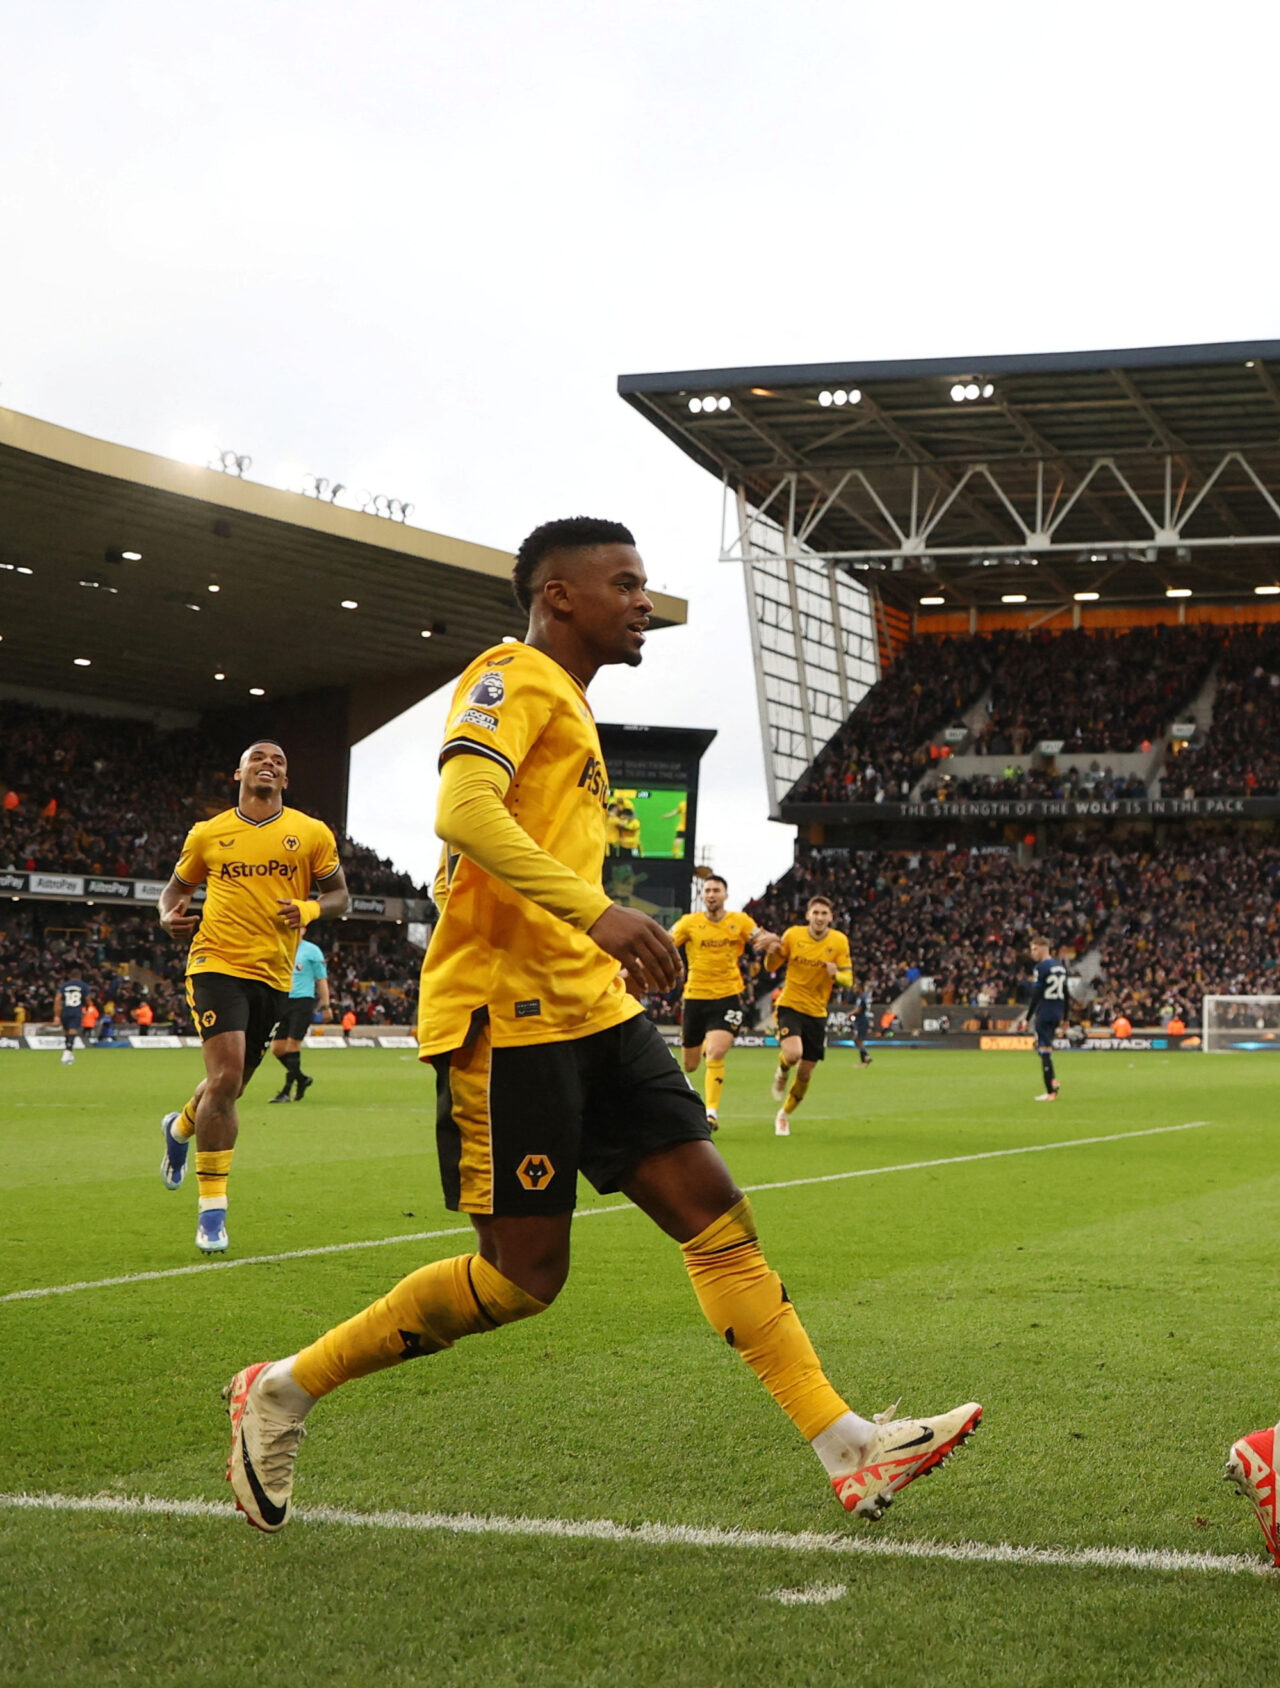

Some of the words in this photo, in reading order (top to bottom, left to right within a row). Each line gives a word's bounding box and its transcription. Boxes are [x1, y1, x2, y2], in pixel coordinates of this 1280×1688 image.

[901, 804, 927, 816] THE
[933, 804, 1010, 816] STRENGTH
[1016, 803, 1035, 815] OF
[1042, 803, 1068, 815] THE
[1075, 801, 1120, 814] WOLF
[1126, 801, 1142, 814] IS
[1149, 801, 1166, 814] IN
[1172, 801, 1200, 813] THE
[1206, 800, 1245, 812] PACK
[219, 859, 298, 881] AstroPay
[0, 875, 24, 893] oPay
[64, 991, 82, 1007] 18
[723, 1009, 743, 1026] 23
[734, 1036, 764, 1048] ACK
